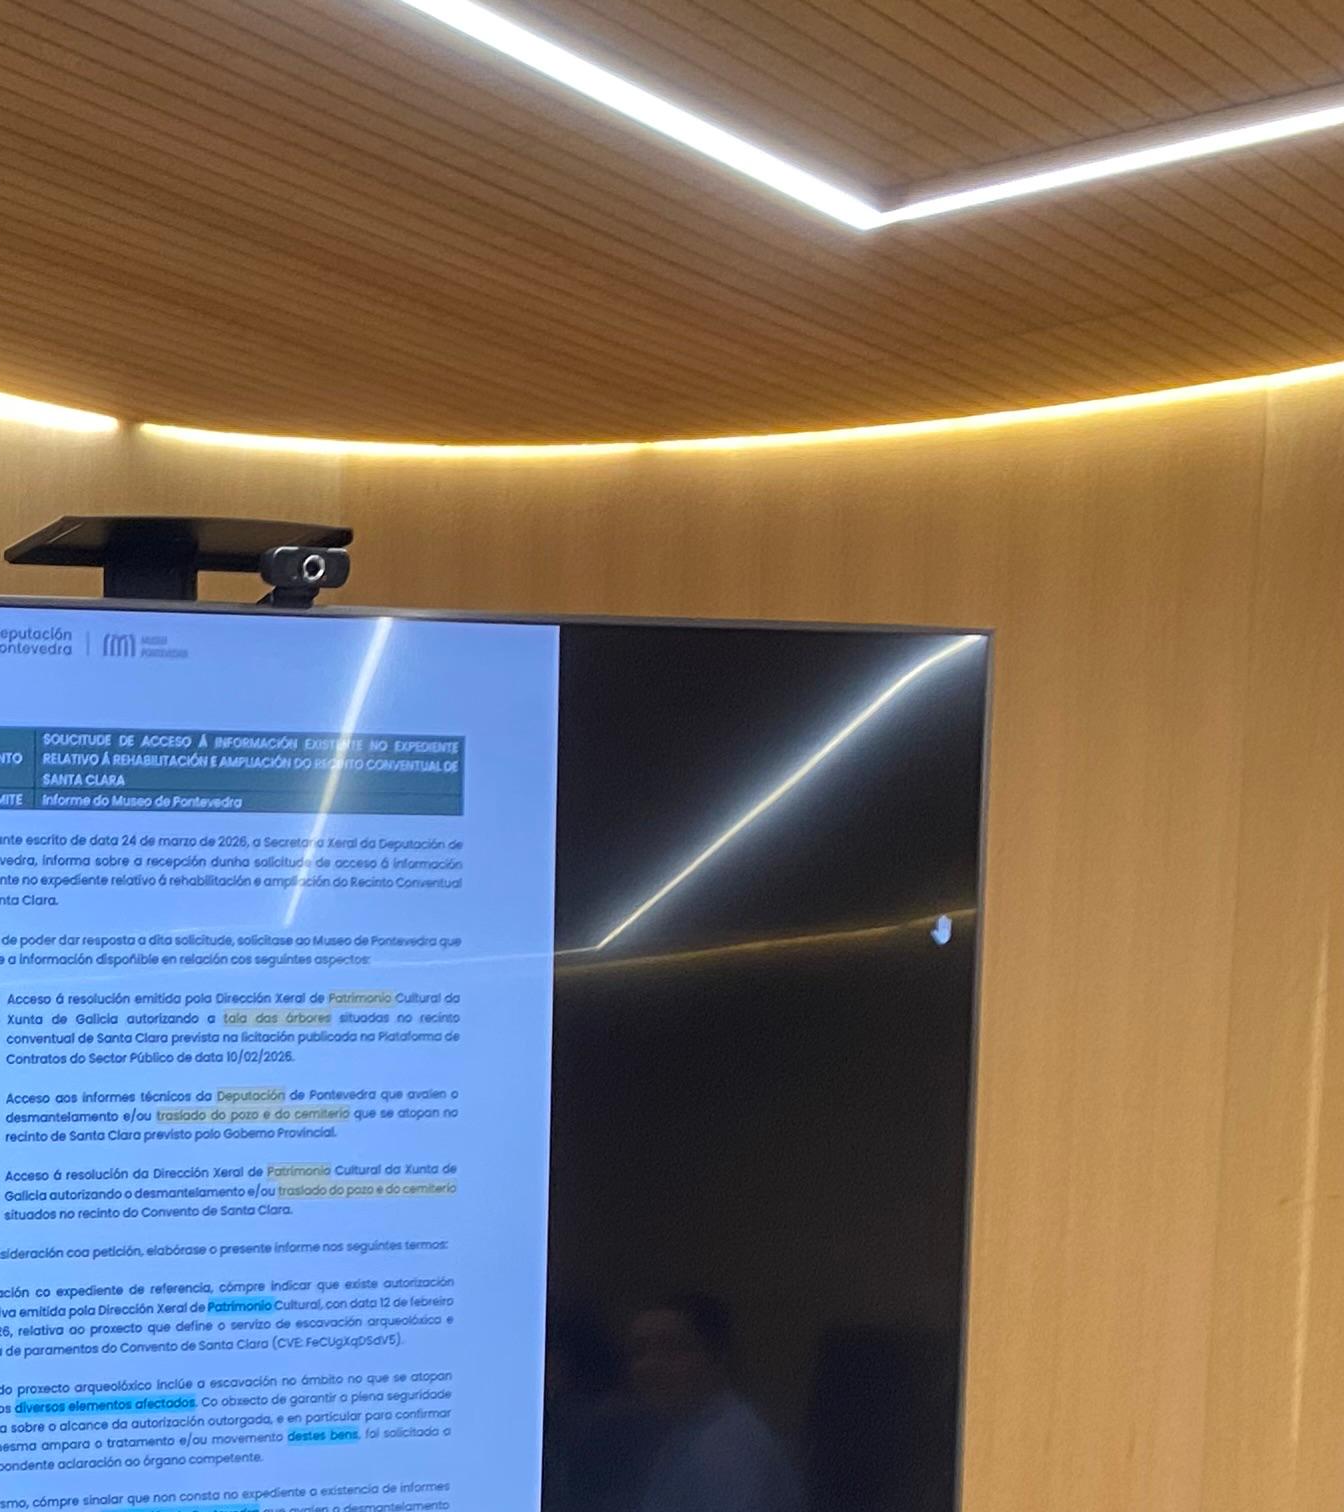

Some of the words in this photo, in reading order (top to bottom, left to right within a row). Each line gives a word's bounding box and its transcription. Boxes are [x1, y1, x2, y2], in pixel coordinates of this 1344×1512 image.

[43, 733, 111, 746] SOLICITUDE
[119, 734, 134, 747] DE
[140, 735, 192, 748] ACCESO
[214, 735, 297, 749] INFORMACIÓN
[370, 740, 388, 751] NO
[394, 741, 459, 753] EXPEDIENTE
[42, 754, 99, 766] RELATIVO
[112, 752, 208, 768] REHABILITACIÓN
[211, 755, 218, 767] E
[218, 754, 292, 769] AMPLIACIÓN
[294, 758, 312, 769] DO
[366, 759, 442, 772] CONVENTUAL
[443, 761, 459, 773] DE
[42, 774, 82, 786] SANTA
[85, 774, 125, 786] CLARA
[42, 794, 91, 807] Informe
[93, 795, 110, 808] do
[111, 795, 153, 808] Museo
[155, 795, 171, 808] de
[173, 796, 242, 809] Pontevedra
[24, 834, 67, 846] escrito
[42, 854, 90, 867] informa
[145, 855, 207, 870] recepción
[39, 874, 109, 889] expediente
[110, 874, 156, 886] relativo
[168, 874, 251, 887] rehabilitación
[349, 875, 394, 888] Recinto
[394, 876, 462, 888] Conventual
[81, 934, 136, 949] resposta
[370, 934, 437, 946] Pontevedra
[18, 952, 93, 964] información
[95, 952, 159, 967] dispoñible
[178, 952, 228, 964] relación
[253, 952, 312, 967] seguintes
[7, 993, 52, 1005] Acceso
[67, 992, 130, 1005] resolución
[133, 992, 182, 1004] emitida
[215, 992, 272, 1004] Dirección
[327, 991, 392, 1004] Patrimonio
[393, 991, 441, 1003] Cultural
[74, 1012, 118, 1025] Galicia
[125, 1012, 199, 1024] autorizando
[338, 1011, 389, 1023] situadas
[418, 1011, 460, 1023] recinto
[6, 1032, 75, 1044] conventual
[170, 1031, 220, 1046] prevista
[240, 1031, 295, 1043] licitación
[296, 1030, 357, 1046] publicada
[377, 1030, 442, 1042] Plataforma
[5, 1052, 67, 1064] Contratos
[87, 1052, 127, 1064] Sector
[128, 1051, 174, 1063] Público
[5, 1092, 50, 1104] Acceso
[81, 1091, 136, 1104] informes
[139, 1091, 191, 1103] técnicos
[216, 1090, 286, 1105] Deputación
[308, 1089, 376, 1101] Pontevedra
[5, 1110, 119, 1123] desmantelamento
[155, 1109, 207, 1121] traslado
[293, 1107, 350, 1120] cemiterio
[5, 1130, 48, 1142] recinto
[143, 1128, 192, 1144] previsto
[222, 1127, 275, 1139] Goberno
[4, 1170, 49, 1182] Acceso
[65, 1168, 129, 1181] resolución
[152, 1167, 209, 1179] Dirección
[266, 1165, 332, 1177] Patrimonio
[333, 1164, 382, 1176] Cultural
[4, 1189, 47, 1201] Galicia
[48, 1187, 122, 1201] autorizando
[133, 1186, 246, 1199] desmantelamento
[277, 1184, 327, 1197] traslado
[401, 1182, 457, 1194] cemiterio
[4, 1207, 57, 1220] situados
[77, 1206, 120, 1219] recinto
[140, 1206, 200, 1218] Convento
[145, 1244, 207, 1257] elabórase
[219, 1243, 272, 1258] presente
[273, 1241, 321, 1254] informe
[345, 1239, 402, 1255] seguintes
[55, 1284, 124, 1300] expediente
[270, 1279, 312, 1292] indicar
[18, 1305, 66, 1317] emitida
[97, 1302, 154, 1315] Dirección
[206, 1299, 272, 1313] Patrimonio
[409, 1294, 454, 1307] febreiro
[17, 1324, 64, 1336] relativa
[89, 1322, 143, 1338] proxecto
[174, 1320, 213, 1332] define
[230, 1318, 272, 1331] servizo
[23, 1343, 99, 1359] paramentos
[119, 1340, 178, 1353] Convento
[16, 1382, 70, 1397] proxecto
[73, 1379, 152, 1395] arqueolóxico
[209, 1375, 277, 1388] escavación
[13, 1401, 66, 1413] diversos
[66, 1399, 132, 1411] elementos
[220, 1394, 269, 1406] obxecto
[288, 1391, 337, 1407] garantir
[386, 1387, 452, 1404] seguridade
[58, 1419, 109, 1431] alcance
[130, 1414, 205, 1429] autorización
[304, 1409, 362, 1426] particular
[394, 1407, 452, 1420] confirmar
[40, 1440, 90, 1453] ampara
[106, 1435, 175, 1448] tratamento
[210, 1431, 283, 1444] movemento
[382, 1425, 439, 1439] solicitada
[56, 1456, 122, 1469] aclaración
[82, 1493, 124, 1506] sinalar
[178, 1490, 220, 1502] consta
[240, 1486, 306, 1502] expediente
[319, 1483, 379, 1497] existencia
[399, 1481, 450, 1493] informes
